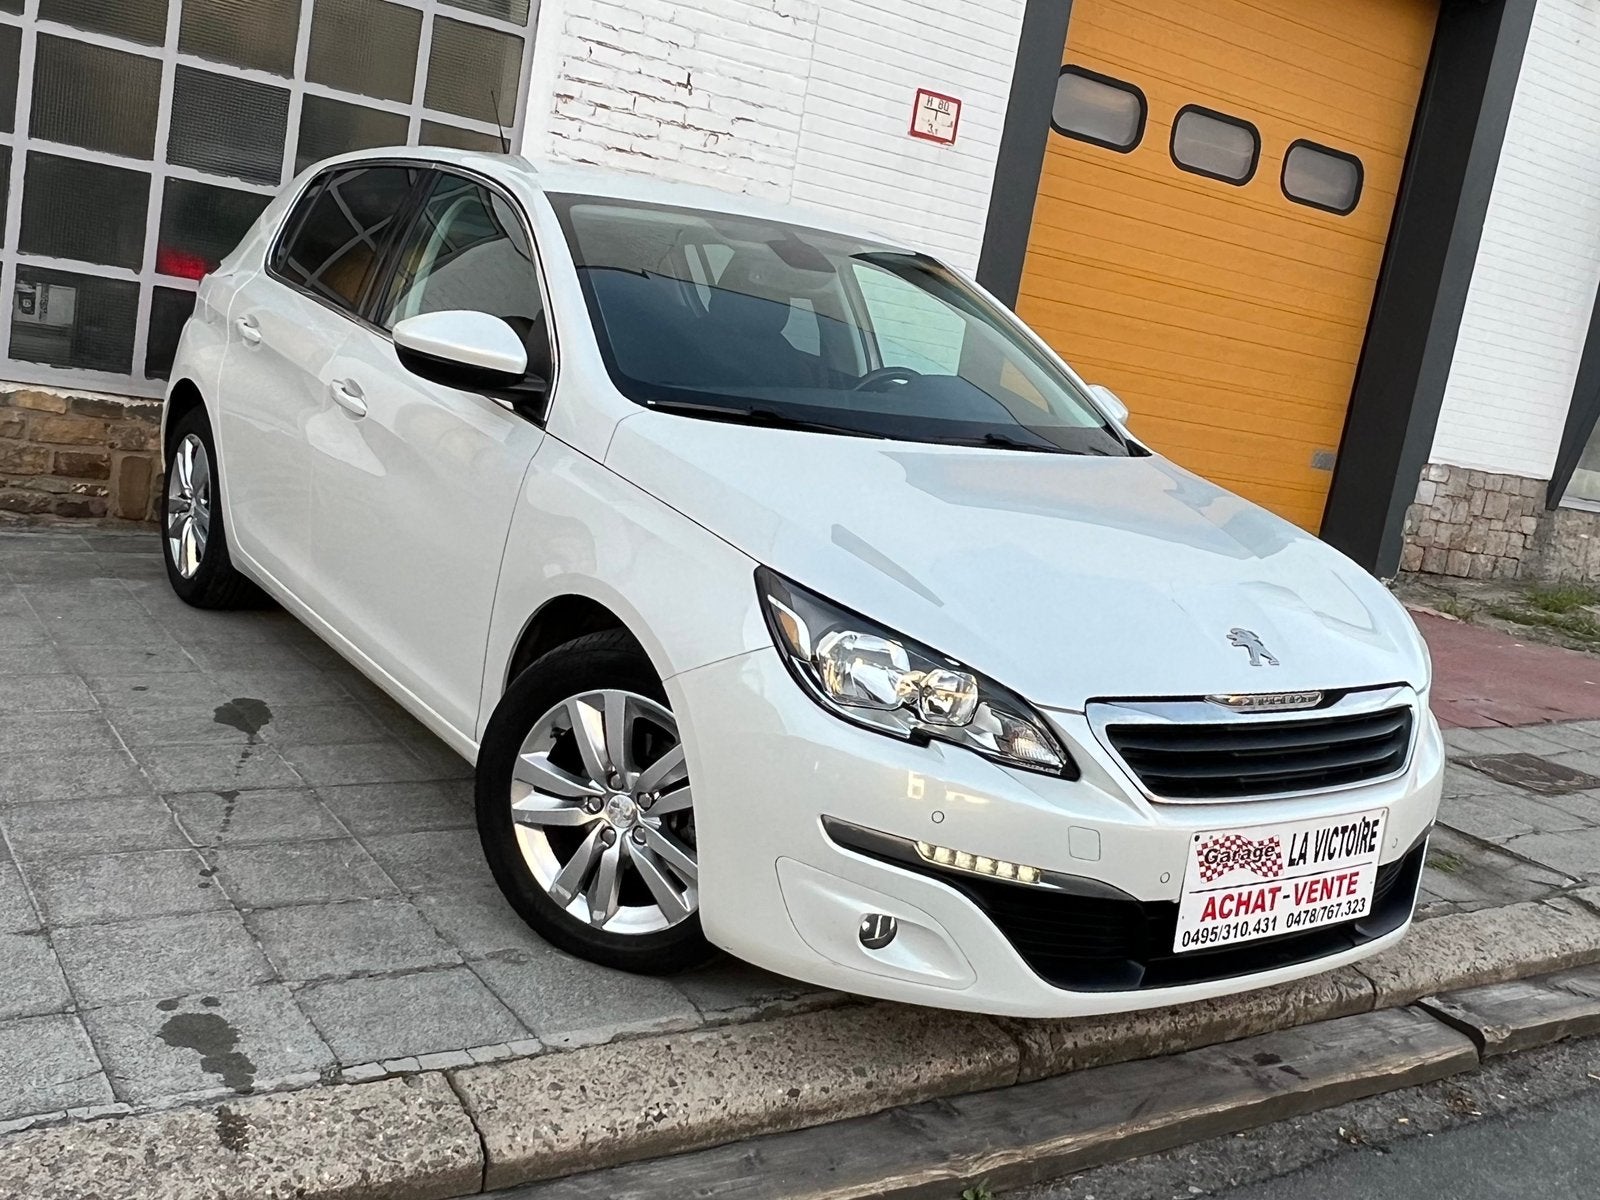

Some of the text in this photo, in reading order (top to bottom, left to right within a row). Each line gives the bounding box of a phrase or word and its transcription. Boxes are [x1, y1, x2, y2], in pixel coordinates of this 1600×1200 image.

[1204, 817, 1380, 868] Garage LA VICTOIRE
[1181, 915, 1278, 947] 0495/310.431
